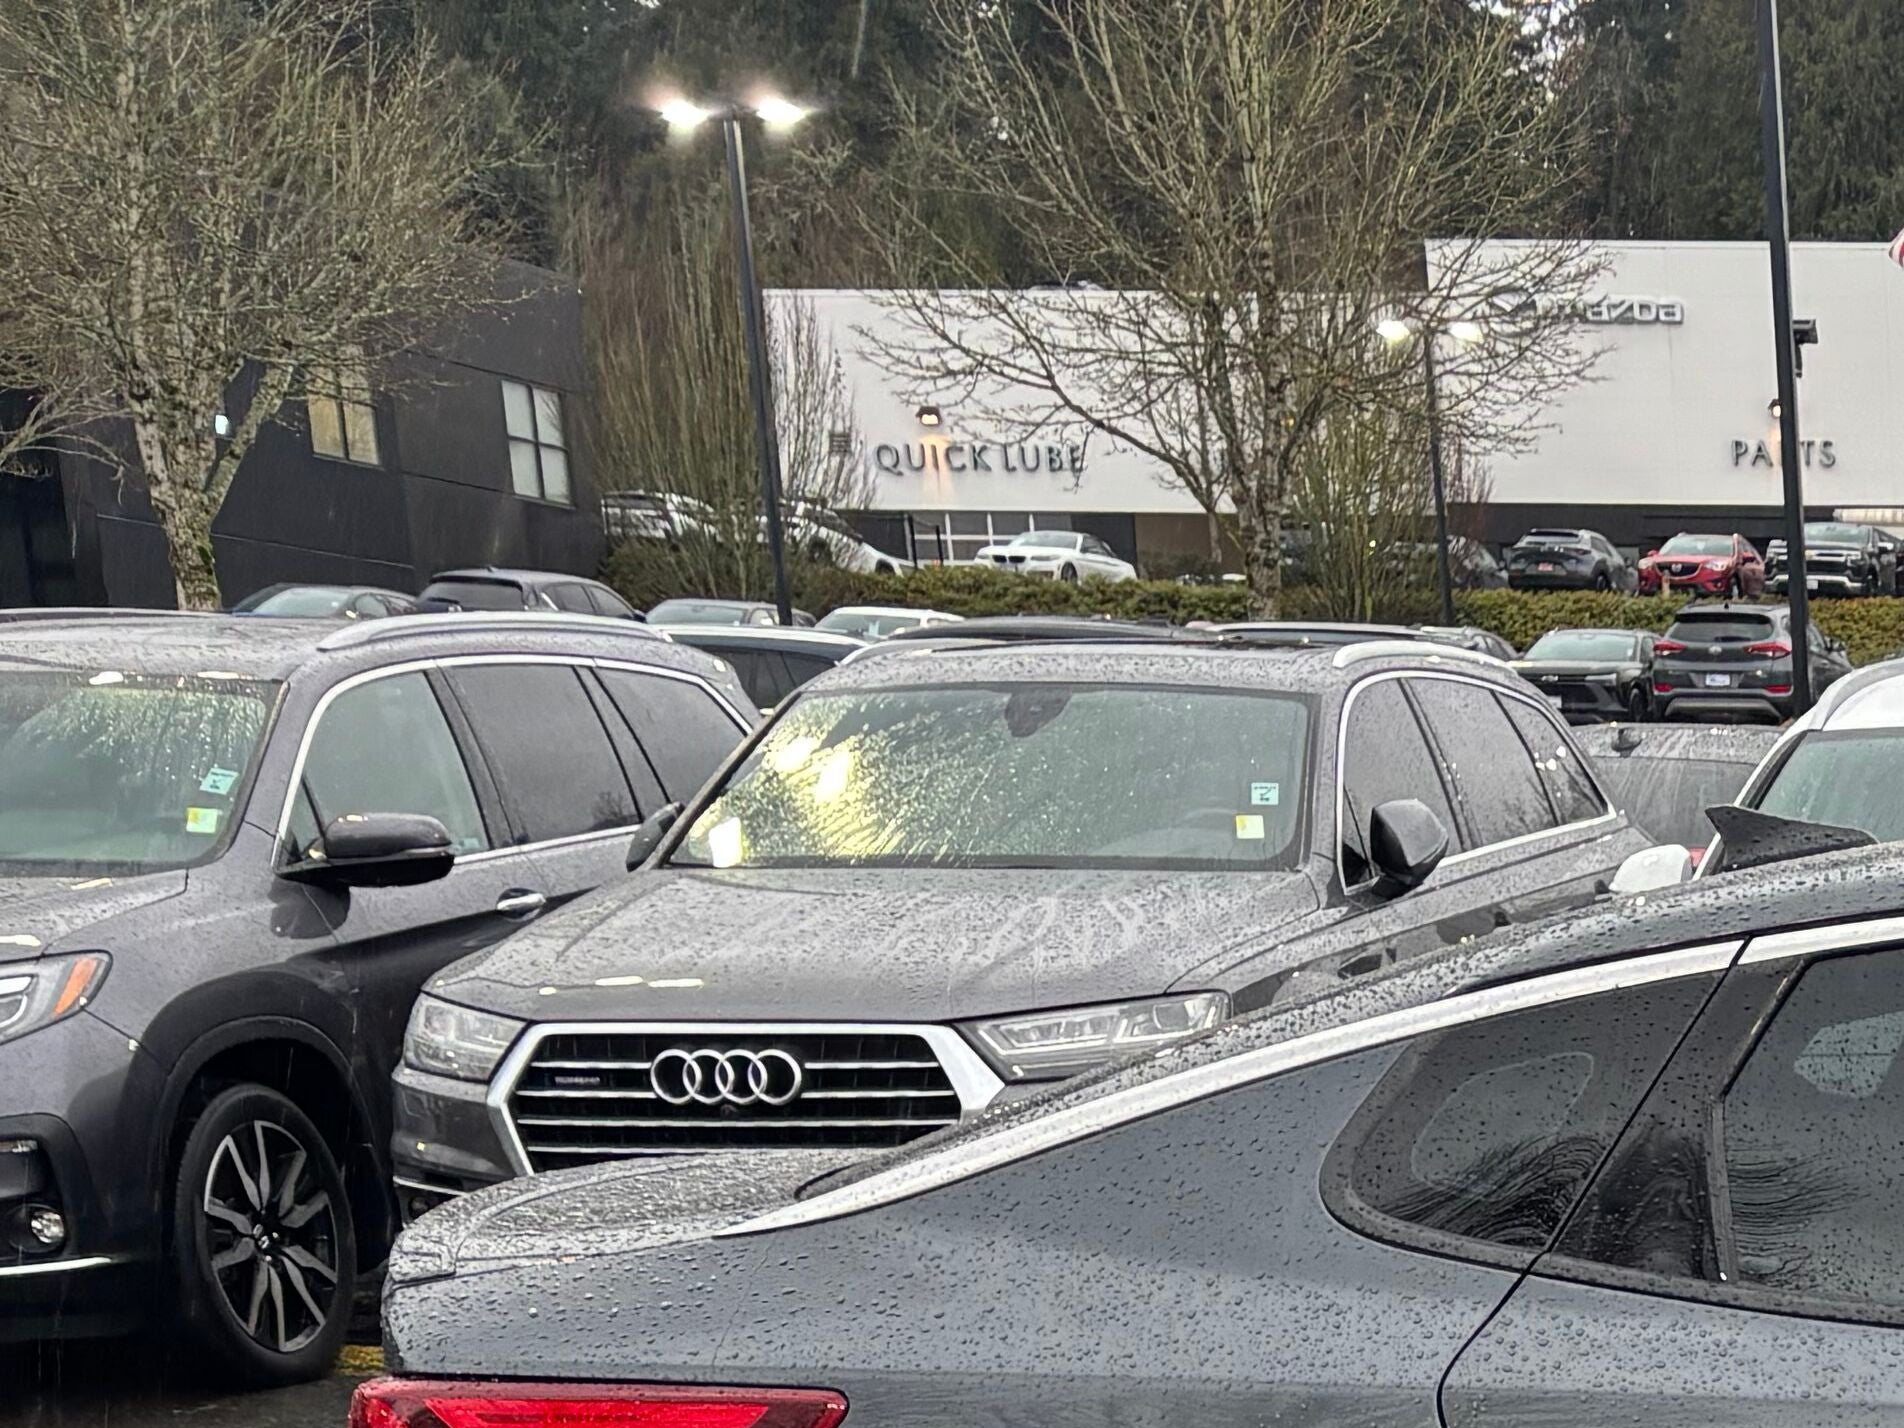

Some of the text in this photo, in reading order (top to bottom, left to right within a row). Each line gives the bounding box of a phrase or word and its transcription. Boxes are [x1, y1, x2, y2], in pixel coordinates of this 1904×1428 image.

[1544, 298, 1684, 324] azda
[876, 444, 1086, 476] QUICK LUBE
[1731, 440, 1836, 468] PATS
